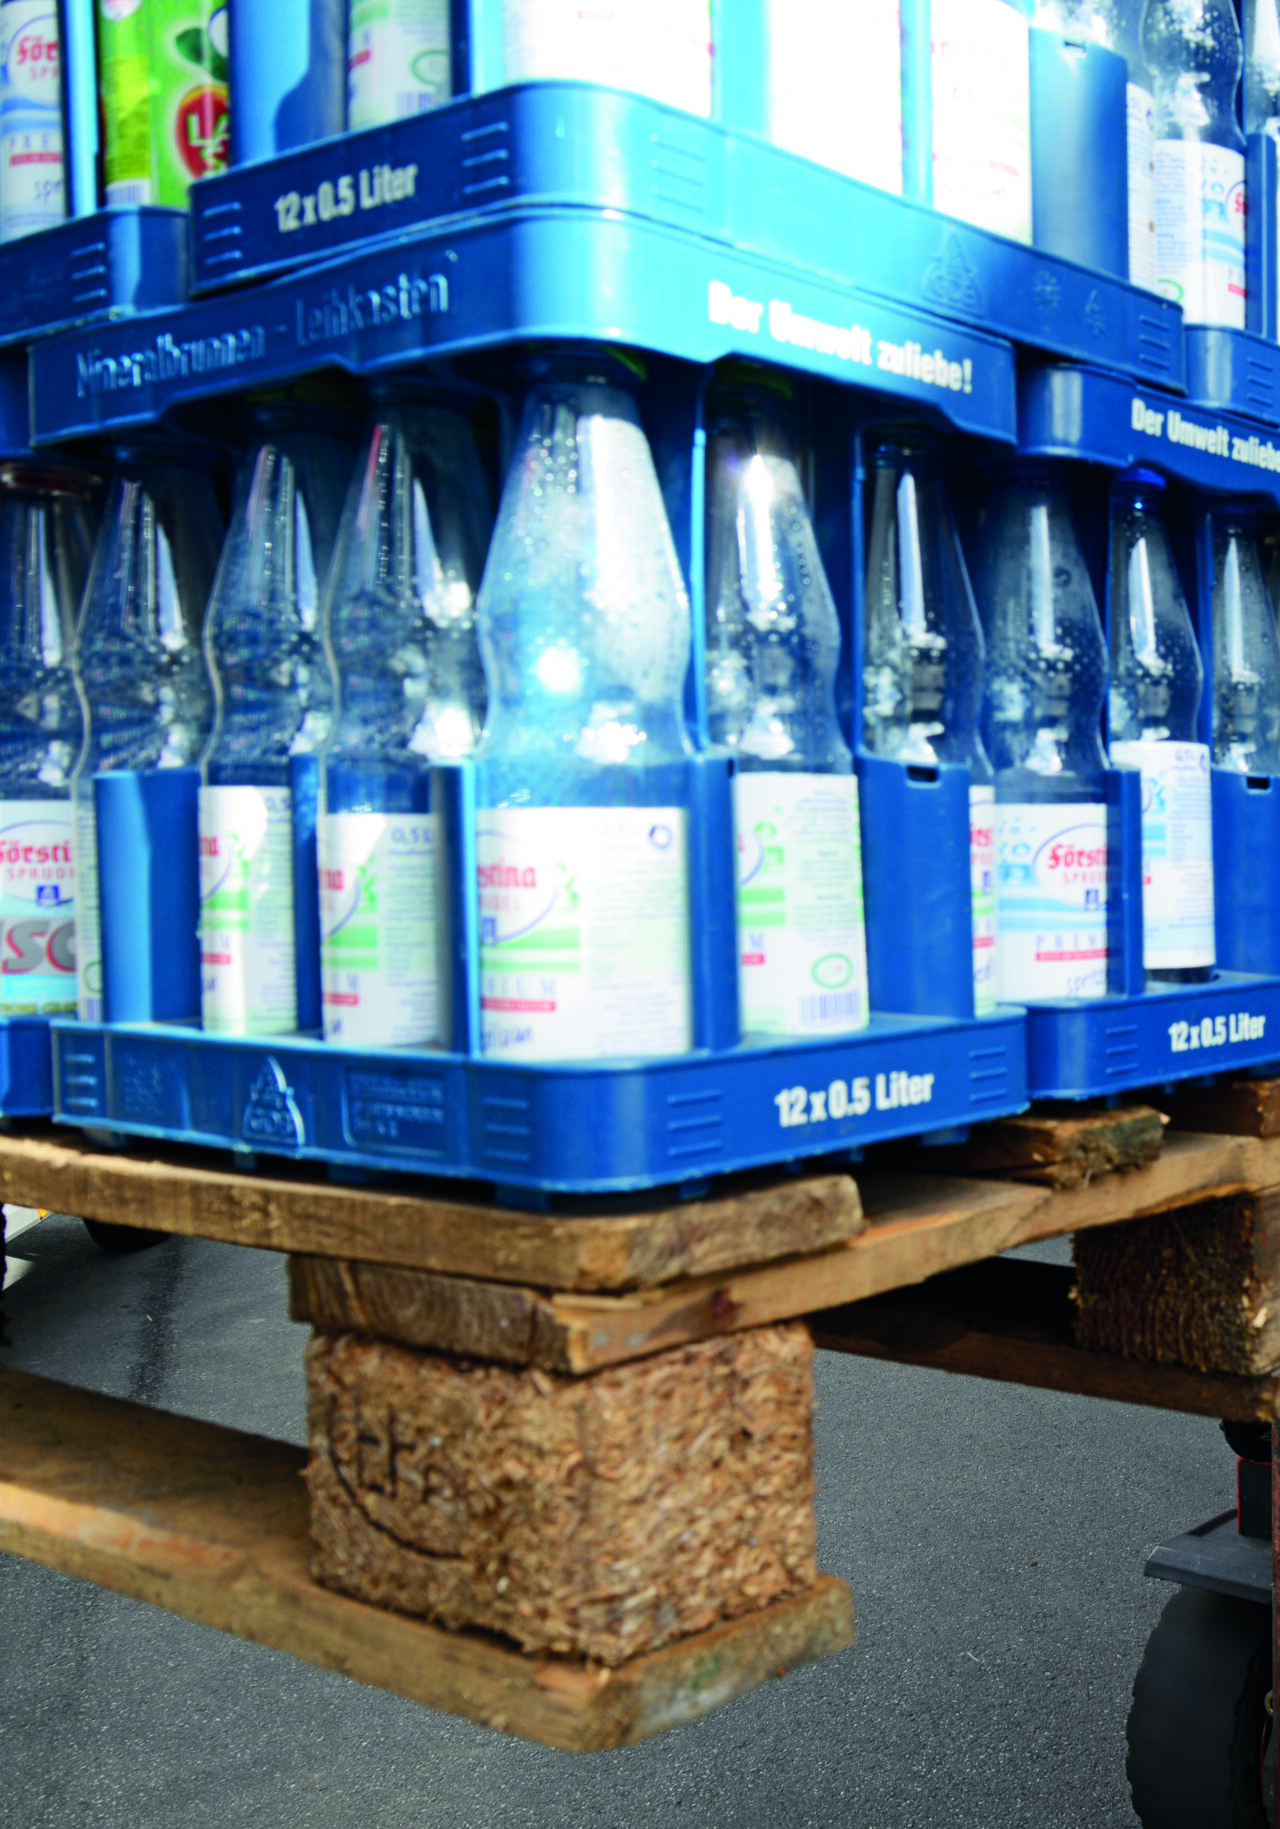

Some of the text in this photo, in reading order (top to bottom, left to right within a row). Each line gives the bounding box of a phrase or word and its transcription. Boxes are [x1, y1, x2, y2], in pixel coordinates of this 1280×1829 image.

[358, 163, 419, 210] Liter
[708, 279, 973, 394] Der Umwelt zuliebe!
[1131, 398, 1164, 437] Der
[1167, 409, 1229, 457] Umwelt
[1229, 1012, 1266, 1045] Liter
[874, 1070, 935, 1110] Liter
